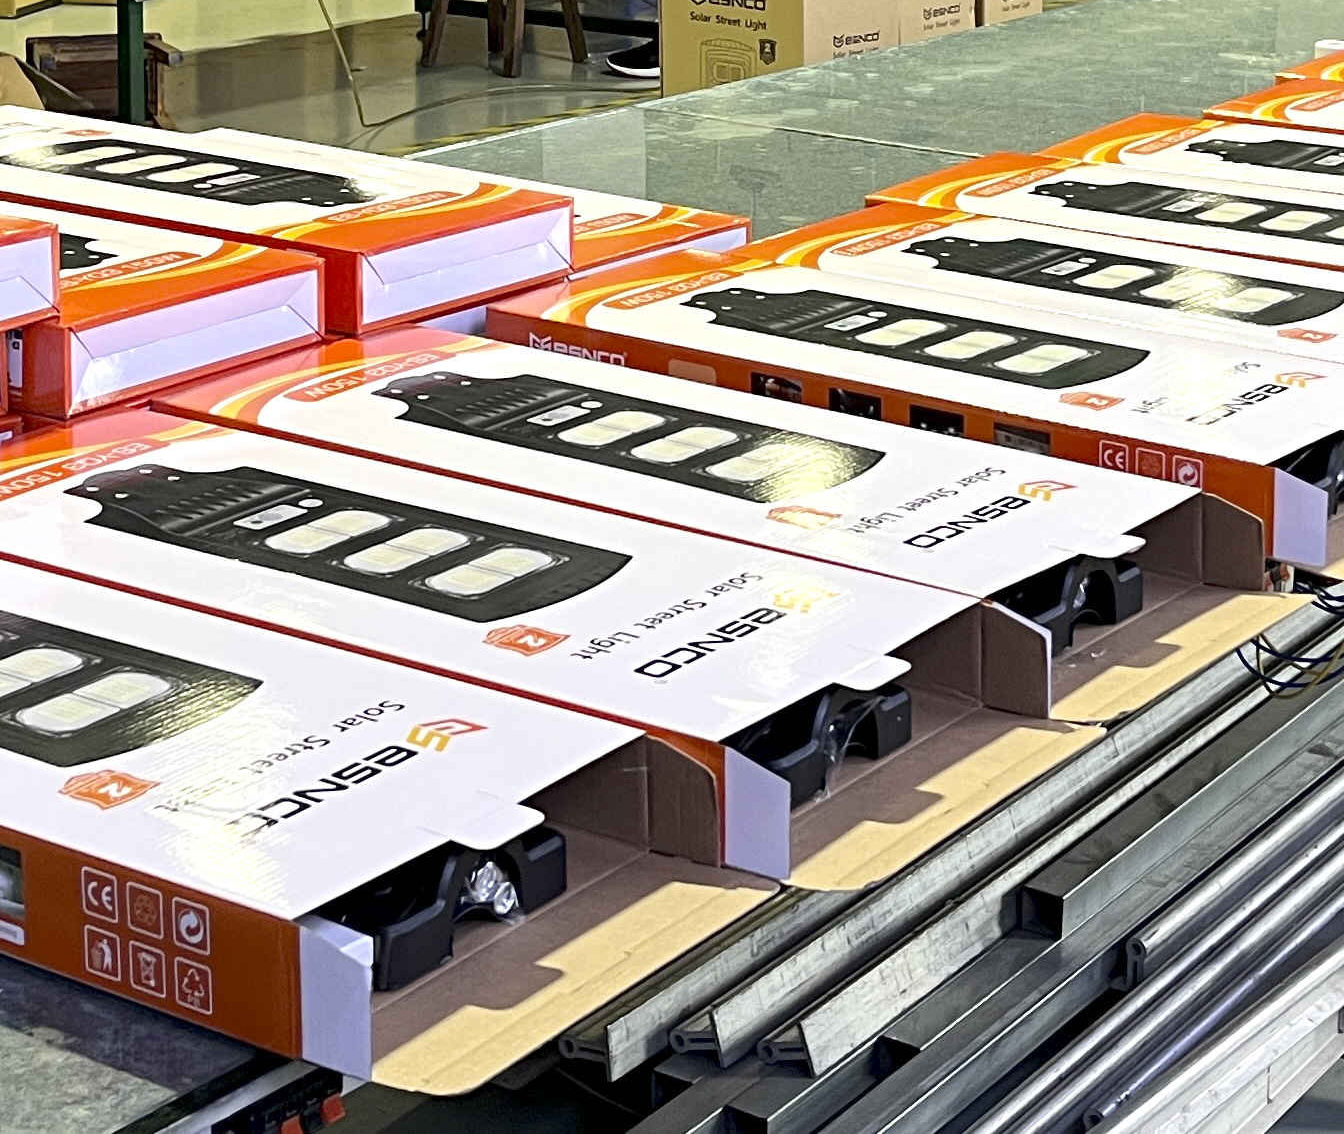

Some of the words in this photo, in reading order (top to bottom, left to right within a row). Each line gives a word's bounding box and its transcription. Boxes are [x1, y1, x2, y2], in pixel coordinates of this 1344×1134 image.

[690, 10, 711, 23] Solar
[715, 15, 741, 28] Street
[745, 19, 767, 32] Light
[1104, 448, 1126, 470] CE
[955, 466, 1006, 487] Solar
[897, 487, 959, 512] Street
[846, 511, 903, 534] Light
[705, 572, 764, 598] Solar
[634, 598, 707, 630] Street
[570, 630, 640, 661] Light
[332, 700, 406, 734] Solar
[239, 734, 331, 776] Street
[87, 879, 113, 913] CE
